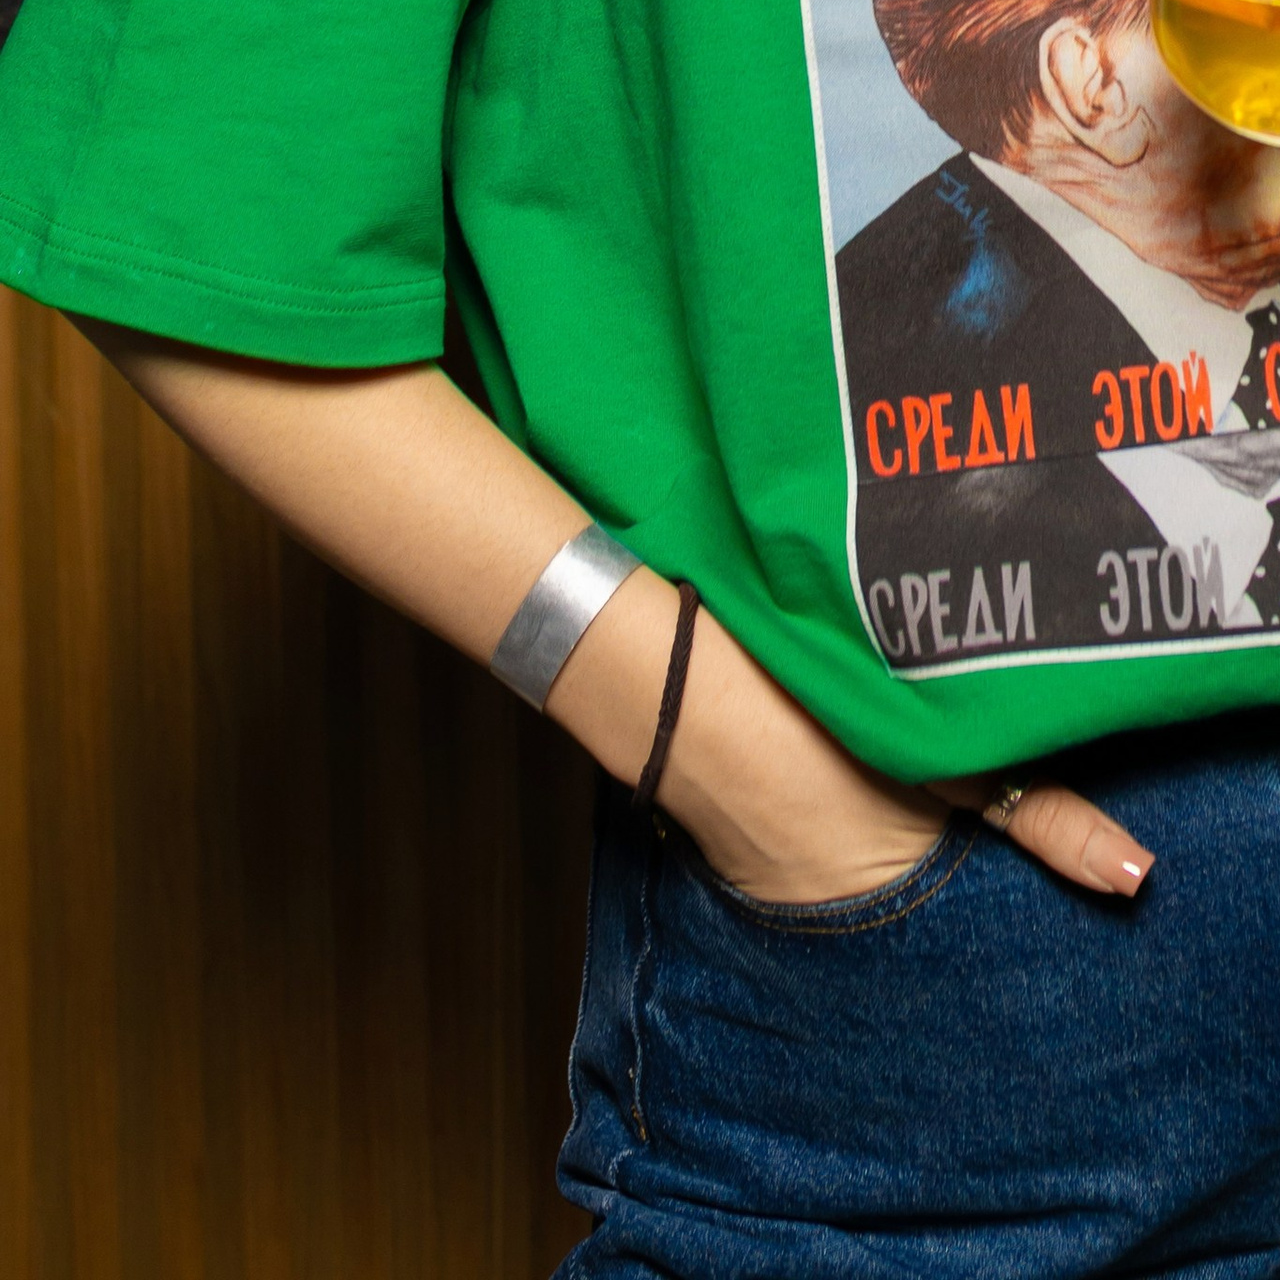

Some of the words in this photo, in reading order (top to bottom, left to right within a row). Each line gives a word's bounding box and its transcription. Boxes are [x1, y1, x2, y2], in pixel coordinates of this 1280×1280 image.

[866, 383, 1036, 477] СРЕДИ
[1092, 350, 1214, 449] ЭТОЙ
[869, 560, 1036, 658] СРЕДИ
[1097, 535, 1226, 636] ЭТОЙ
